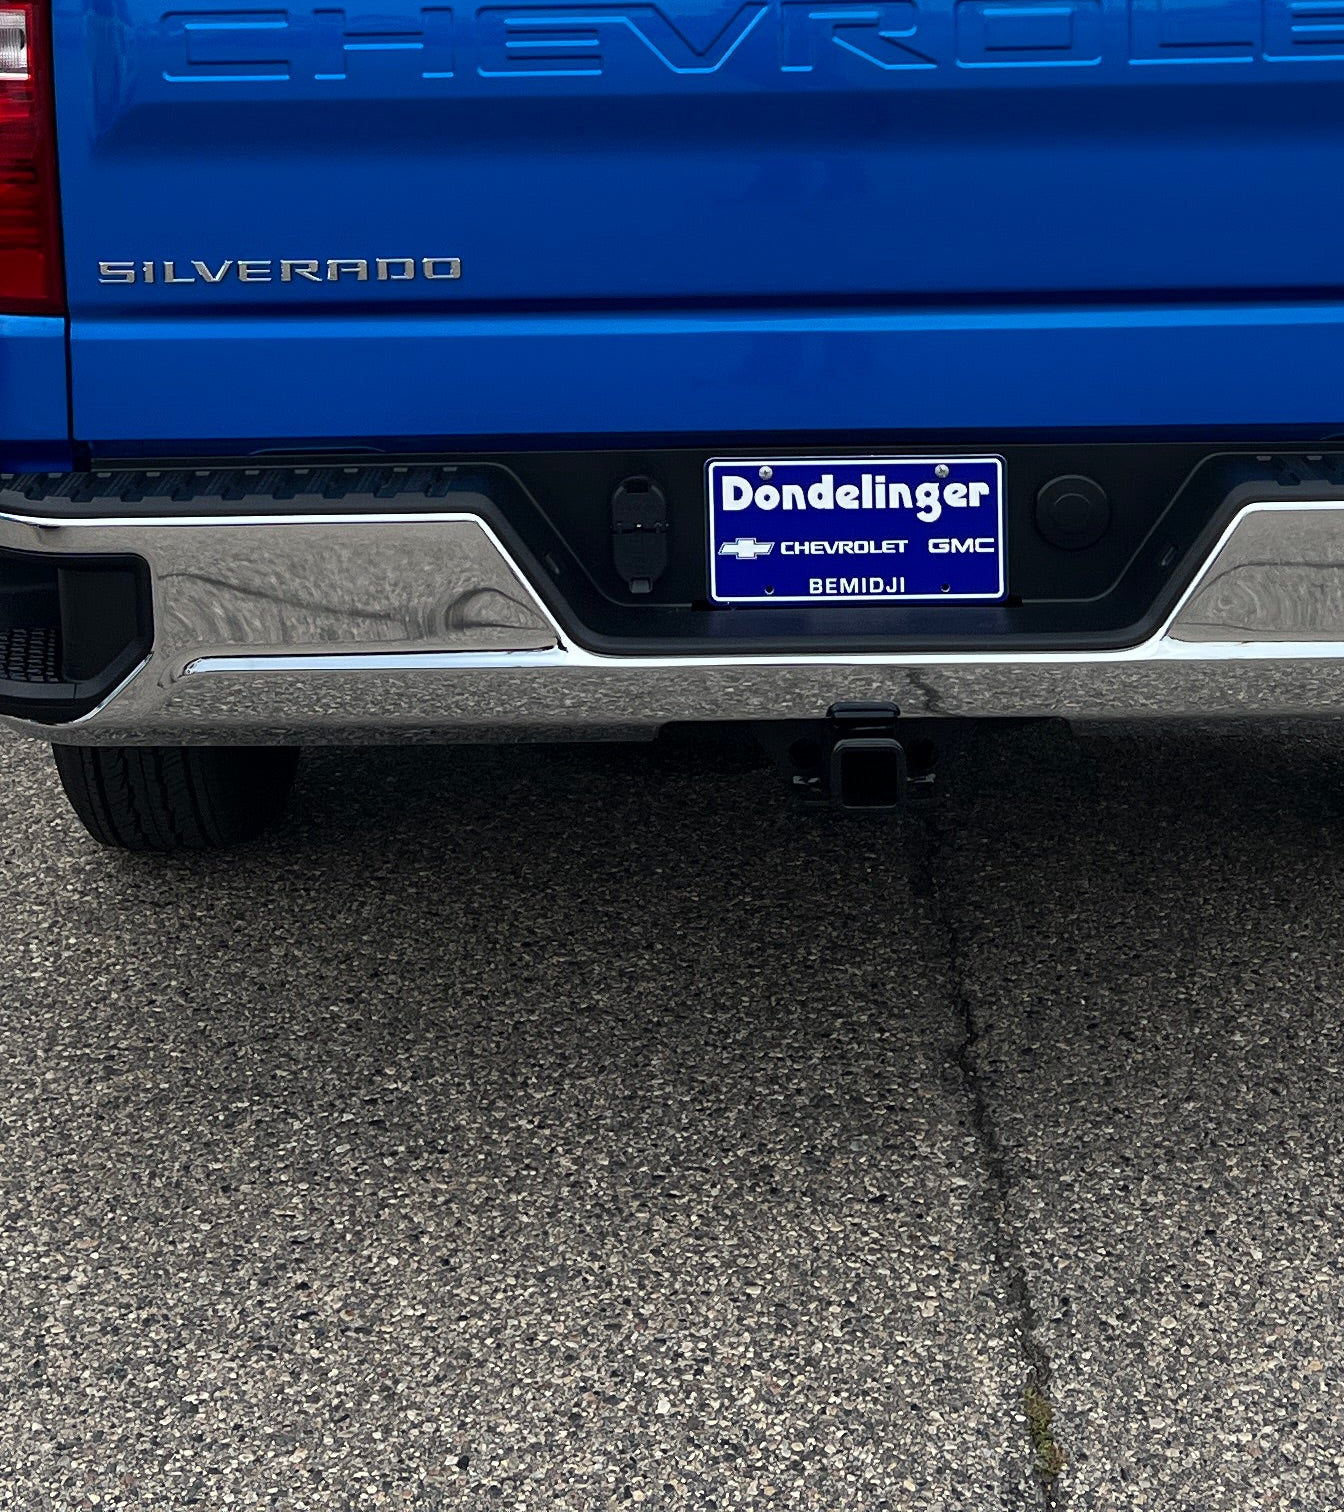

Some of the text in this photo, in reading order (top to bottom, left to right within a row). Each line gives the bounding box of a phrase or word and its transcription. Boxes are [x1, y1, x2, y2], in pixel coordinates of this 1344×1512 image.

[98, 257, 461, 283] SILVERADO
[721, 473, 990, 523] Dondelinger
[780, 537, 995, 555] CHEVROLET GMC
[809, 576, 905, 594] BEMIDJI
